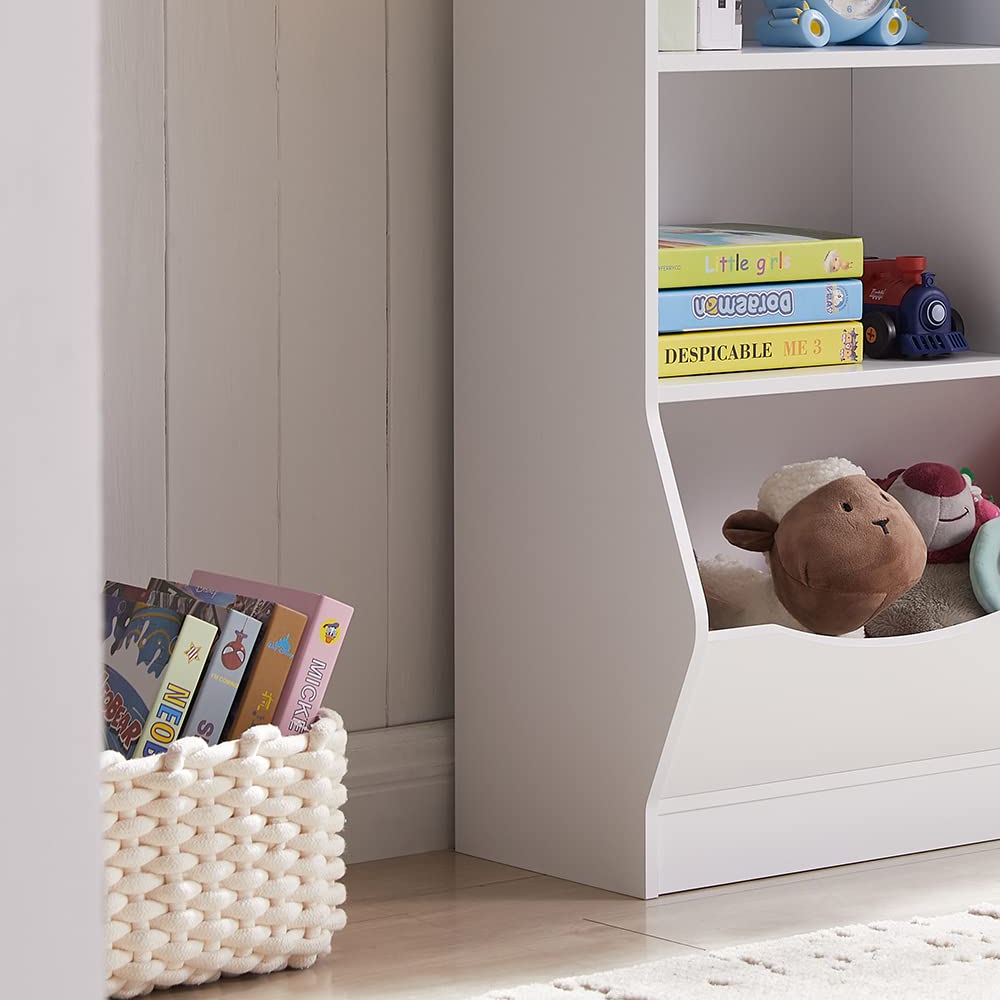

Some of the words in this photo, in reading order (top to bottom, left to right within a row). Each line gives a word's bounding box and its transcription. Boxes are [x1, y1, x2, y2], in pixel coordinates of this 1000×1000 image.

[704, 253, 749, 274] Little
[756, 251, 792, 276] grls
[692, 288, 794, 320] Doraemon
[665, 342, 773, 365] DESPICABLE
[783, 339, 808, 357] ME
[812, 339, 822, 355] 3
[103, 682, 143, 750] OBEAR
